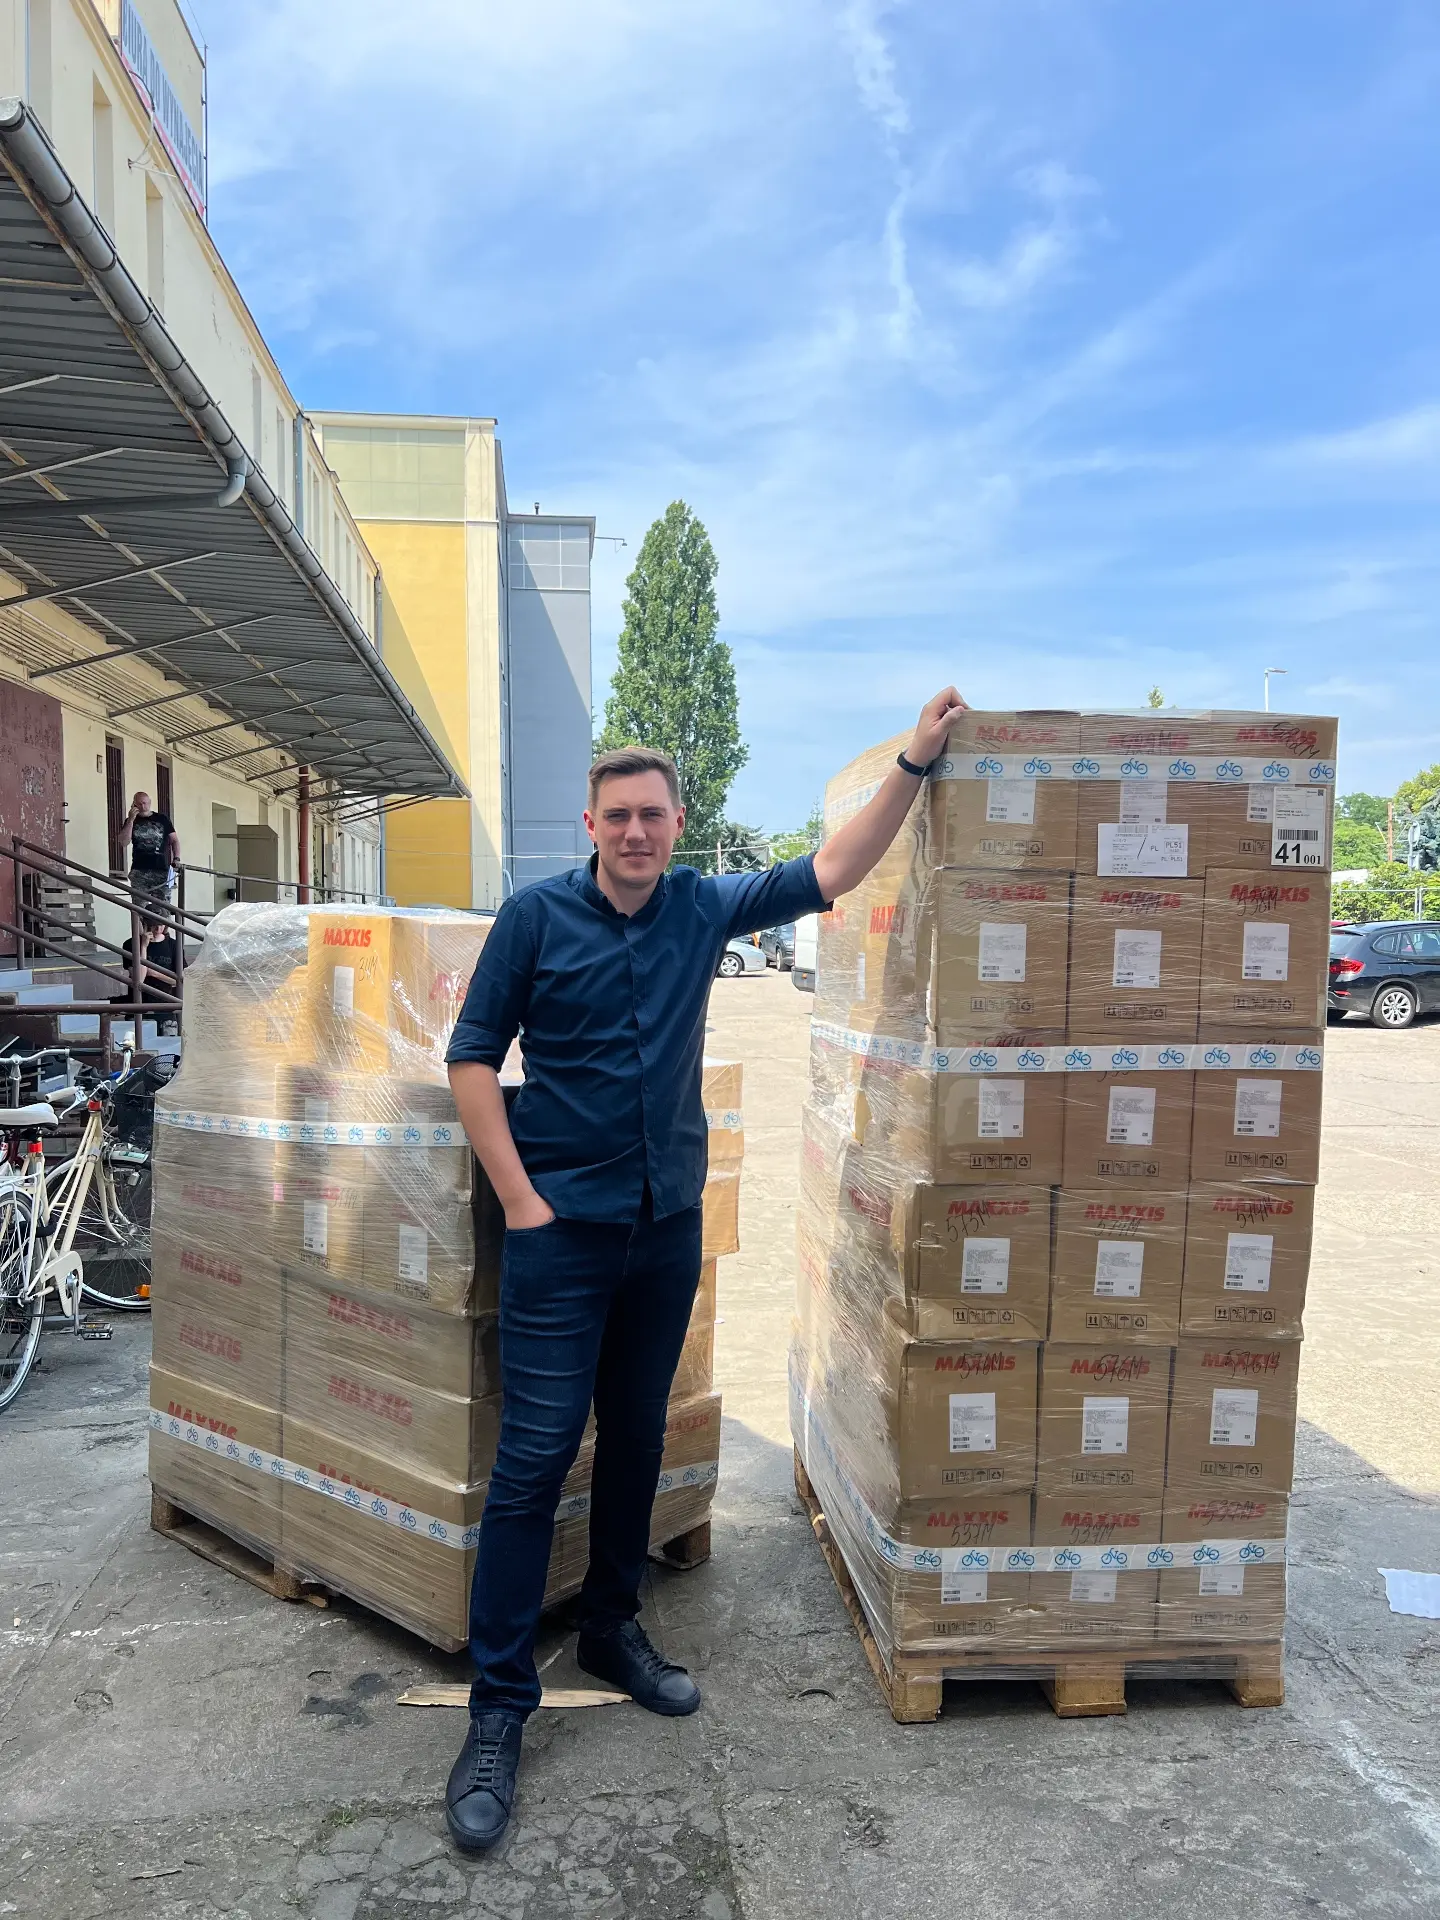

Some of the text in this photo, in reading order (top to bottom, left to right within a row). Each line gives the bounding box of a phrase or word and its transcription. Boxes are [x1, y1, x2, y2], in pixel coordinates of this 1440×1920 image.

[1275, 843, 1321, 864] 41 001
[323, 928, 372, 947] MAXXIS
[948, 1200, 1030, 1217] MAXXIS
[1084, 1204, 1166, 1222] MAXXIS
[935, 1355, 1016, 1371] MAXXIS
[926, 1511, 1009, 1527] MAXXIS
[1060, 1511, 1141, 1527] MAXXIS
